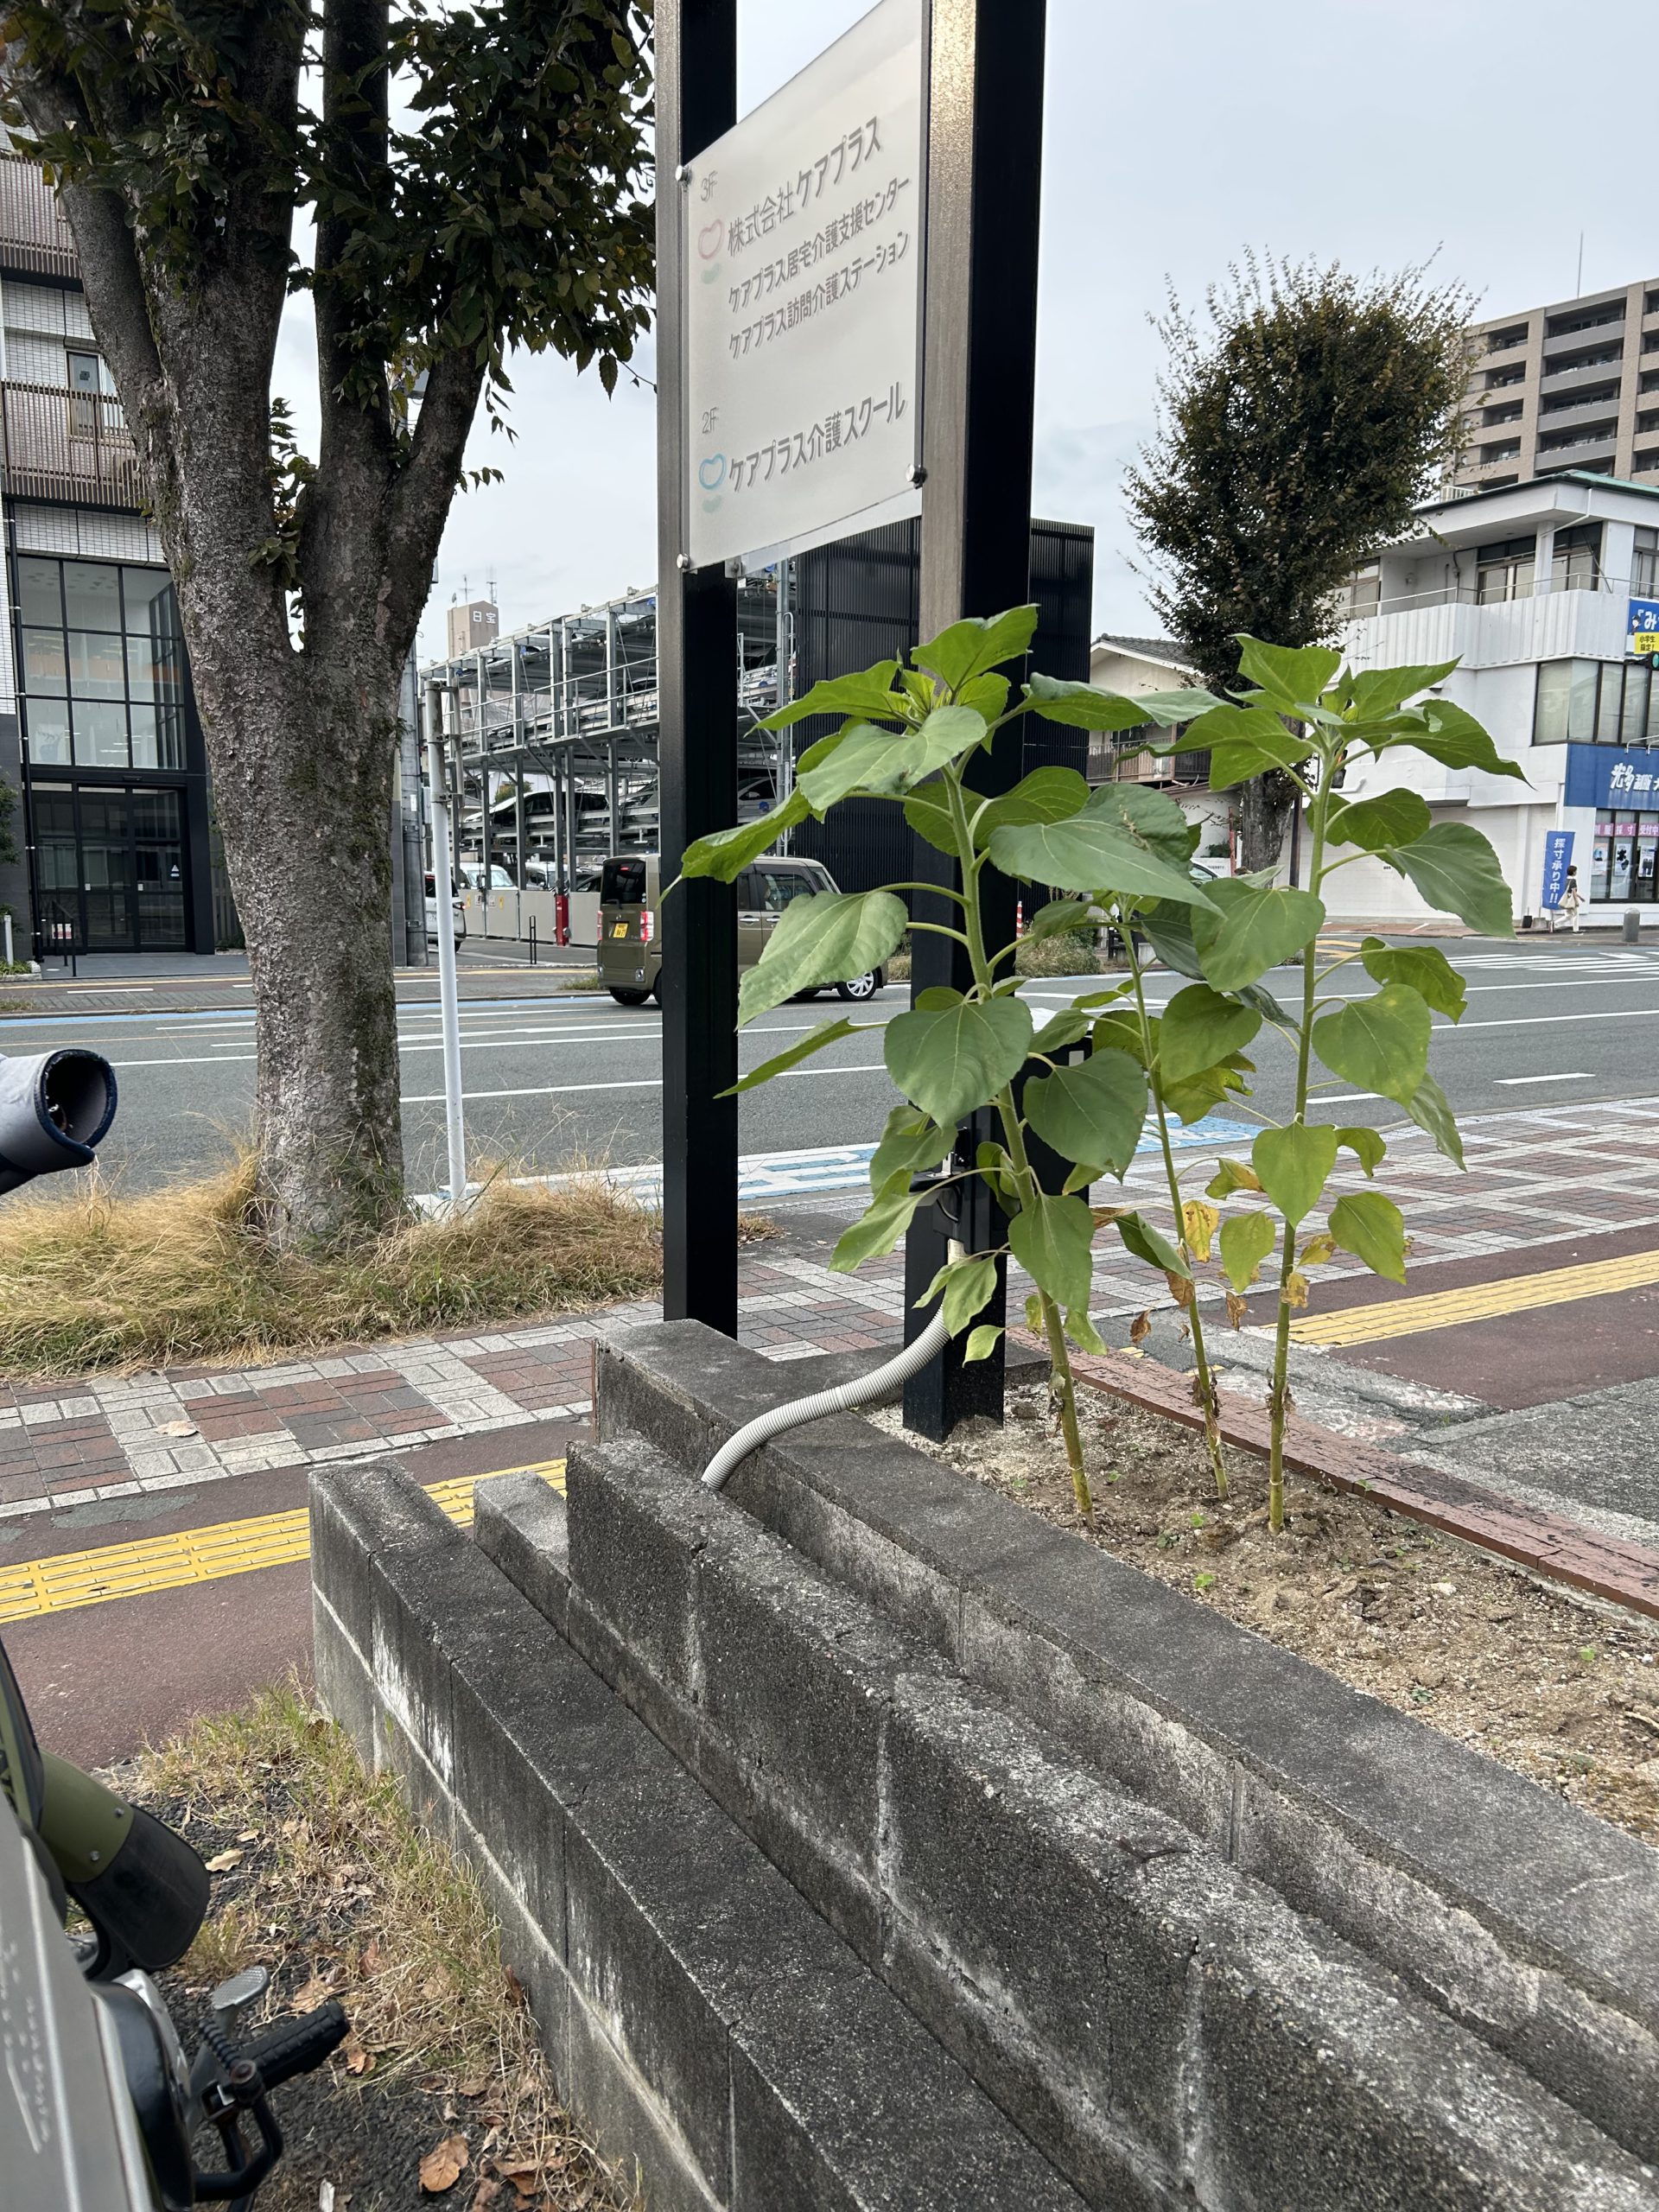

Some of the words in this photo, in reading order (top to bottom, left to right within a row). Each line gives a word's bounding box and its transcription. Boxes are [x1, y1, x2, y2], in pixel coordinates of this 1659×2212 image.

[701, 170, 718, 202] 3F
[728, 116, 880, 257] 株式会社ケアプラス
[728, 178, 909, 313] ケアプラス居宅介護支援センター
[729, 231, 909, 359] ケアプラス訪問介護ステーション
[702, 406, 719, 435] 2F
[729, 381, 906, 492] ケアプラス介護スクール
